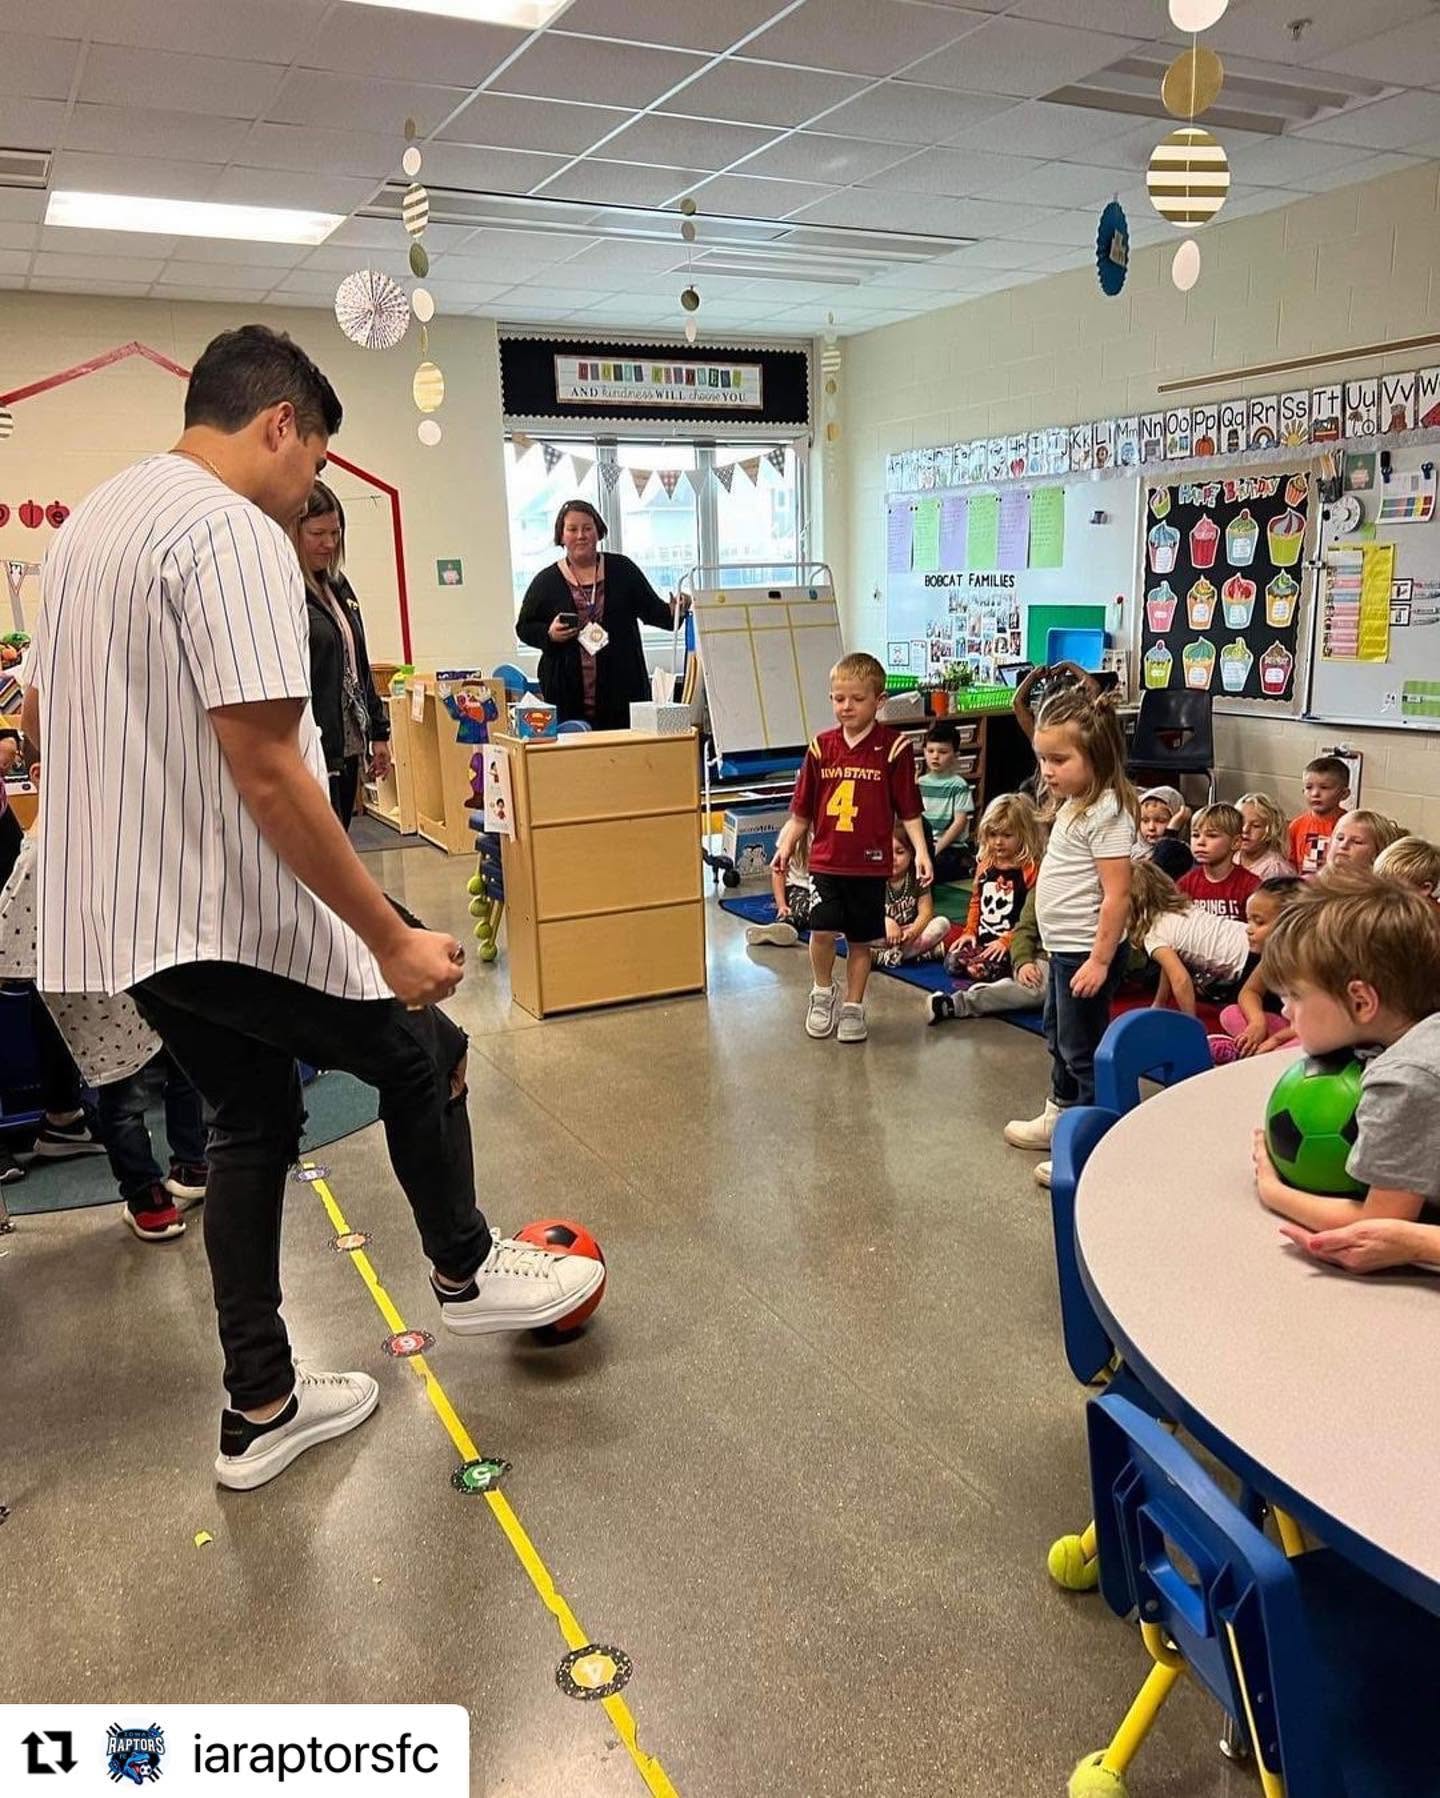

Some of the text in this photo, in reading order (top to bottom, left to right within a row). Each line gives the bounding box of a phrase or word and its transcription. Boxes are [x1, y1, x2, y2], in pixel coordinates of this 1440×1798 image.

[1117, 421, 1138, 437] Mm
[1142, 418, 1162, 438] Nn
[1167, 413, 1190, 435] Oo
[1194, 410, 1216, 435] Pp
[1222, 406, 1245, 430] Qq
[1251, 401, 1276, 425] Rr
[1282, 396, 1307, 420] Ss
[1314, 390, 1339, 415] Tt
[1347, 385, 1376, 410] Uu
[1383, 379, 1414, 404] Vv
[924, 573, 1015, 588] BOBCAT FAMILIES
[844, 767, 881, 780] STATE
[826, 780, 858, 832] 4
